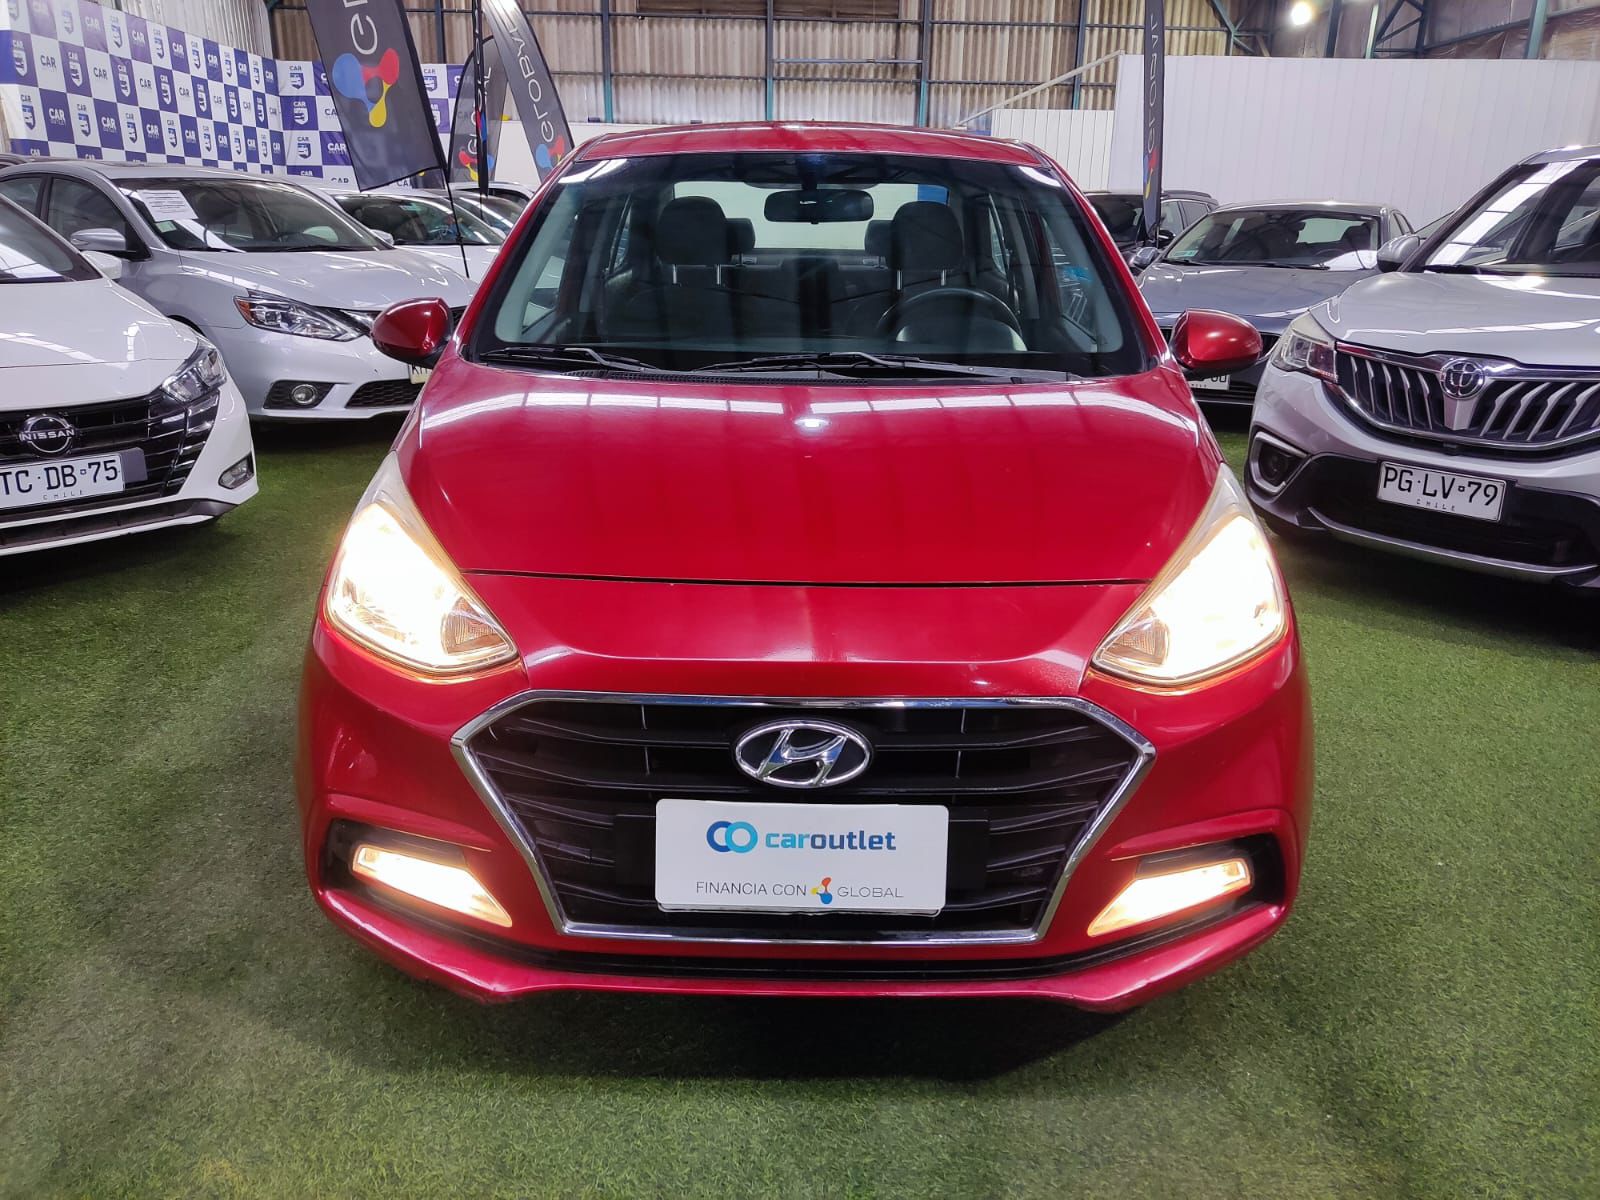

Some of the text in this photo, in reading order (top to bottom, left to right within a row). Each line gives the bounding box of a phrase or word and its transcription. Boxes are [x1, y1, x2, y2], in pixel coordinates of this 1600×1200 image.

[132, 29, 146, 43] CAR
[40, 55, 56, 68] CAR
[93, 67, 108, 80] CAR
[140, 78, 152, 89] CAR
[20, 94, 31, 102] CAR
[179, 87, 190, 97] CAR
[49, 108, 65, 120] CAR
[101, 117, 116, 129] CAR
[146, 124, 159, 135] CAR
[184, 130, 195, 139] CAR
[327, 143, 347, 151] CAR
[22, 429, 75, 441] NISSAN
[765, 830, 896, 850] caroutlet
[696, 881, 904, 898] FINANCIA CON GLOBAL
